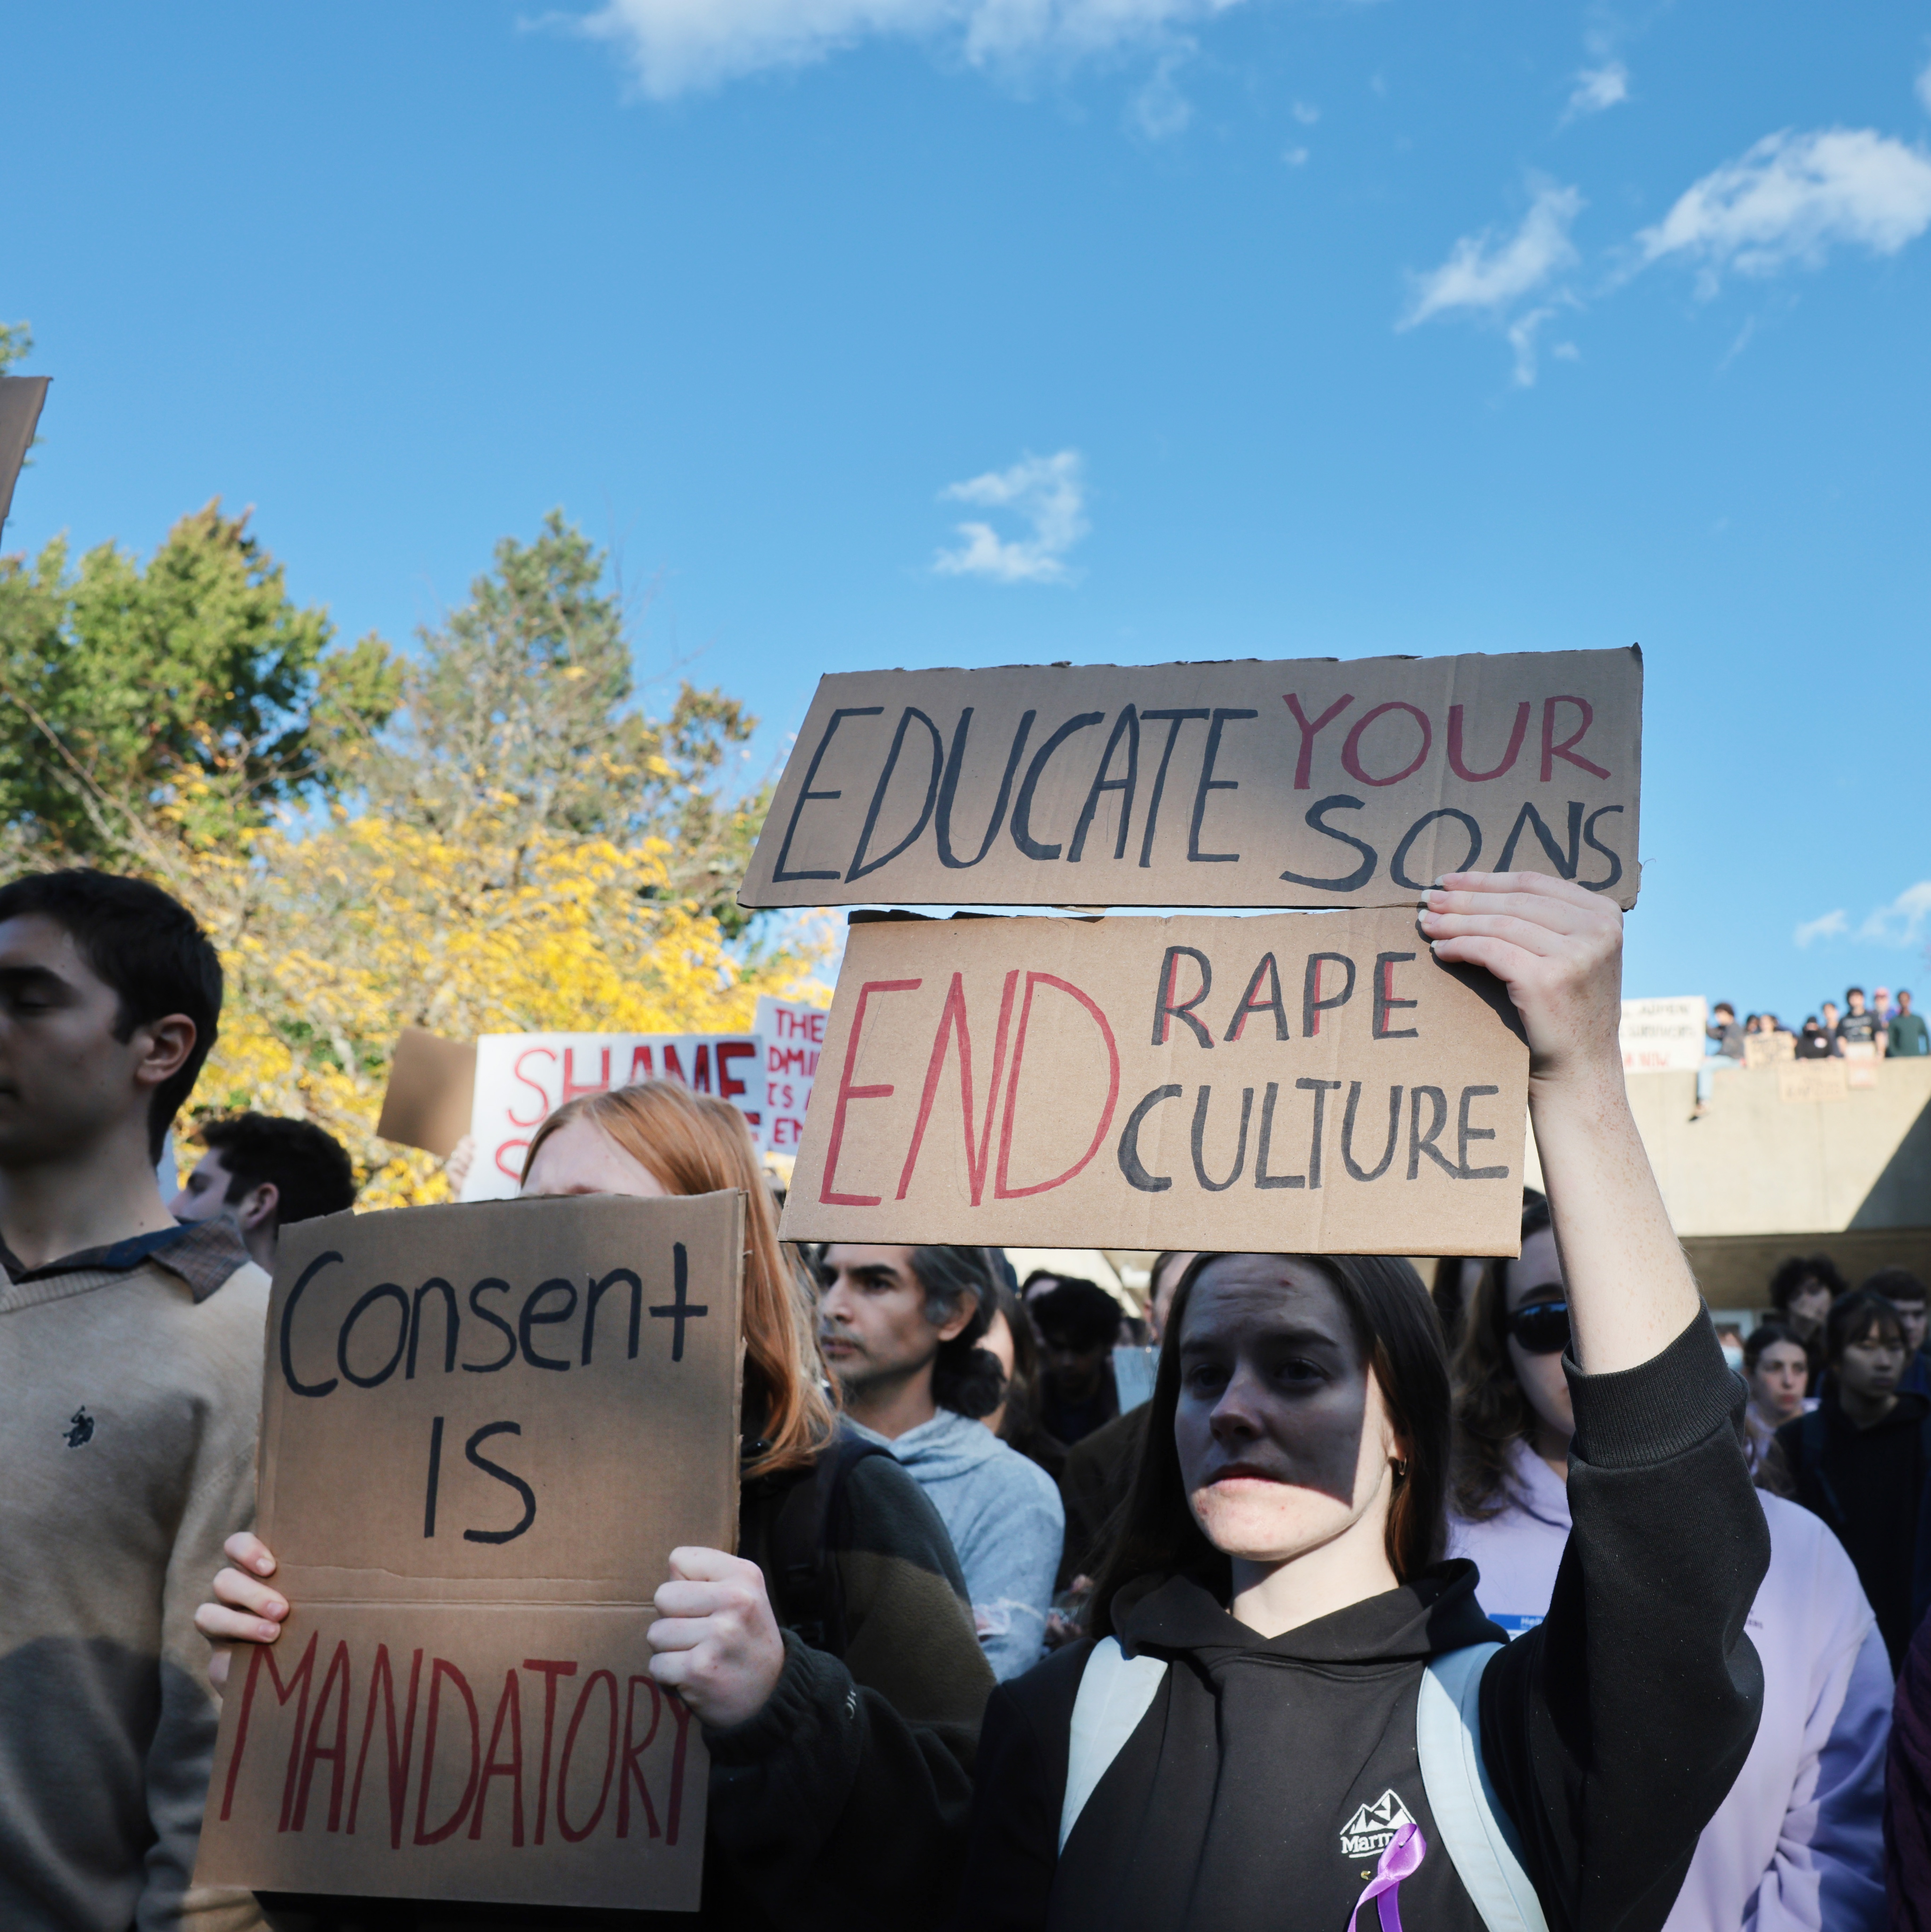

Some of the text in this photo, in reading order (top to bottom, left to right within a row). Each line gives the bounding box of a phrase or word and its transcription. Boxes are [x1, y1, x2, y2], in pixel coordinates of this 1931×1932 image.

[772, 692, 1611, 884] EDUCATE YOUR
[1279, 794, 1624, 892] SONS
[776, 1008, 825, 1043] THE
[819, 945, 1419, 1207] END RAPE
[1117, 1077, 1510, 1193] CULTURE
[280, 1241, 708, 1398] Consent
[424, 1416, 536, 1545] IS
[219, 1630, 692, 1850] MANDATORY
[1340, 1832, 1394, 1854] Marm
